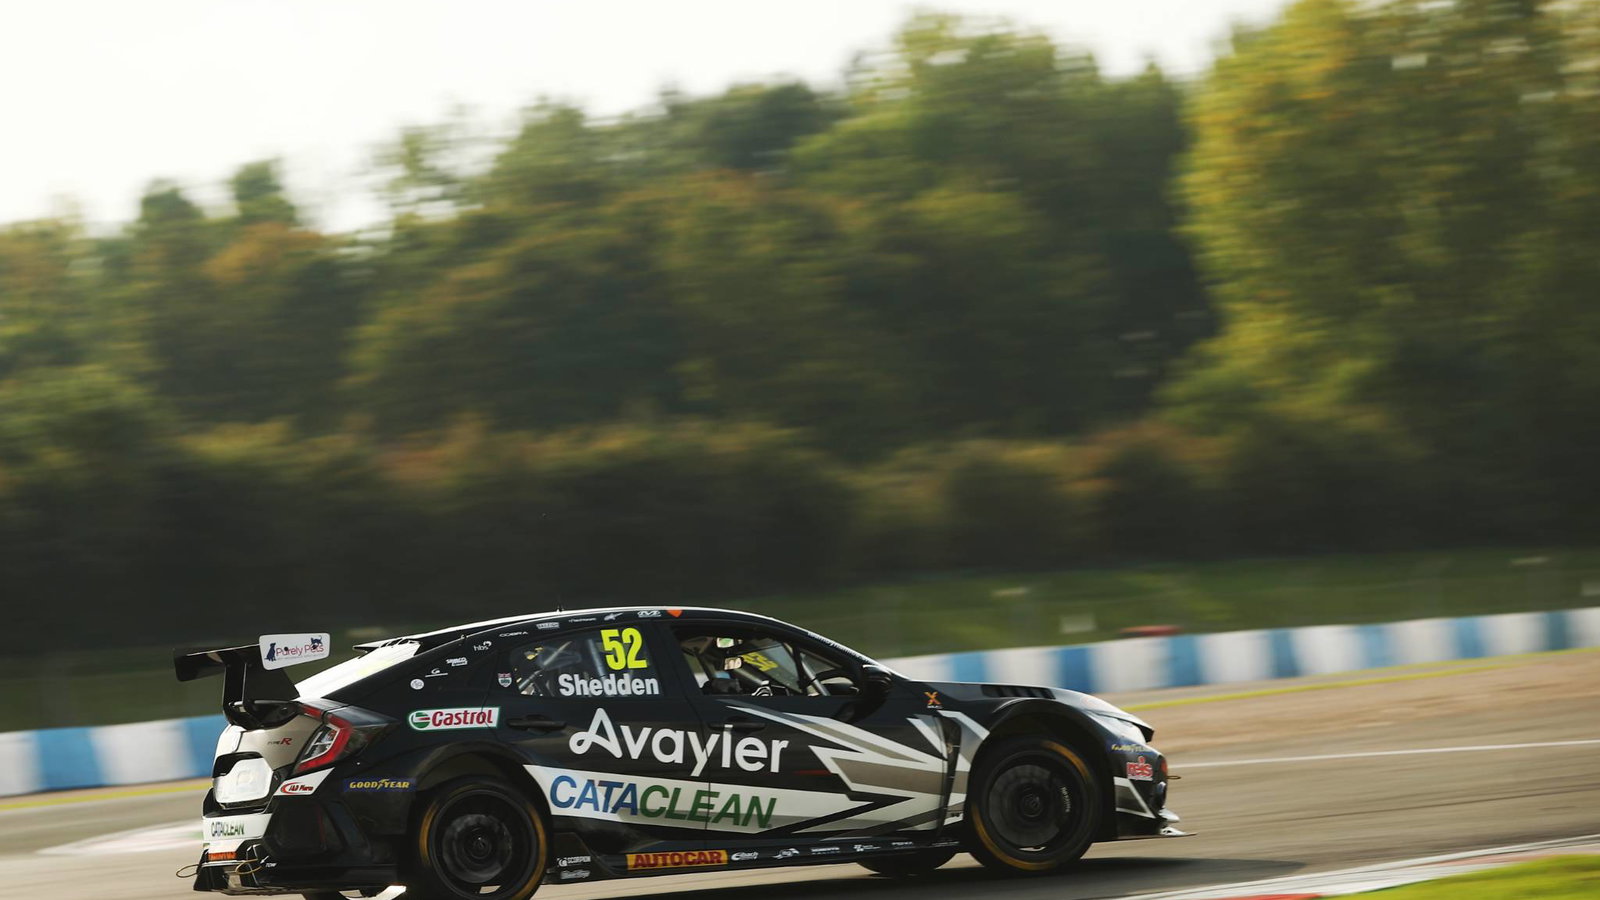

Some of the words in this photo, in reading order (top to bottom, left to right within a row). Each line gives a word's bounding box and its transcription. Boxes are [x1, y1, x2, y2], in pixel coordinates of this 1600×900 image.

[276, 645, 303, 656] Purely
[601, 628, 647, 670] 52
[558, 673, 660, 696] Shedden
[432, 709, 493, 727] Castrol
[280, 737, 293, 745] R
[549, 775, 777, 829] CATACLEAN
[211, 820, 245, 837] CATACLEAN
[633, 851, 723, 868] AUTOCAR
